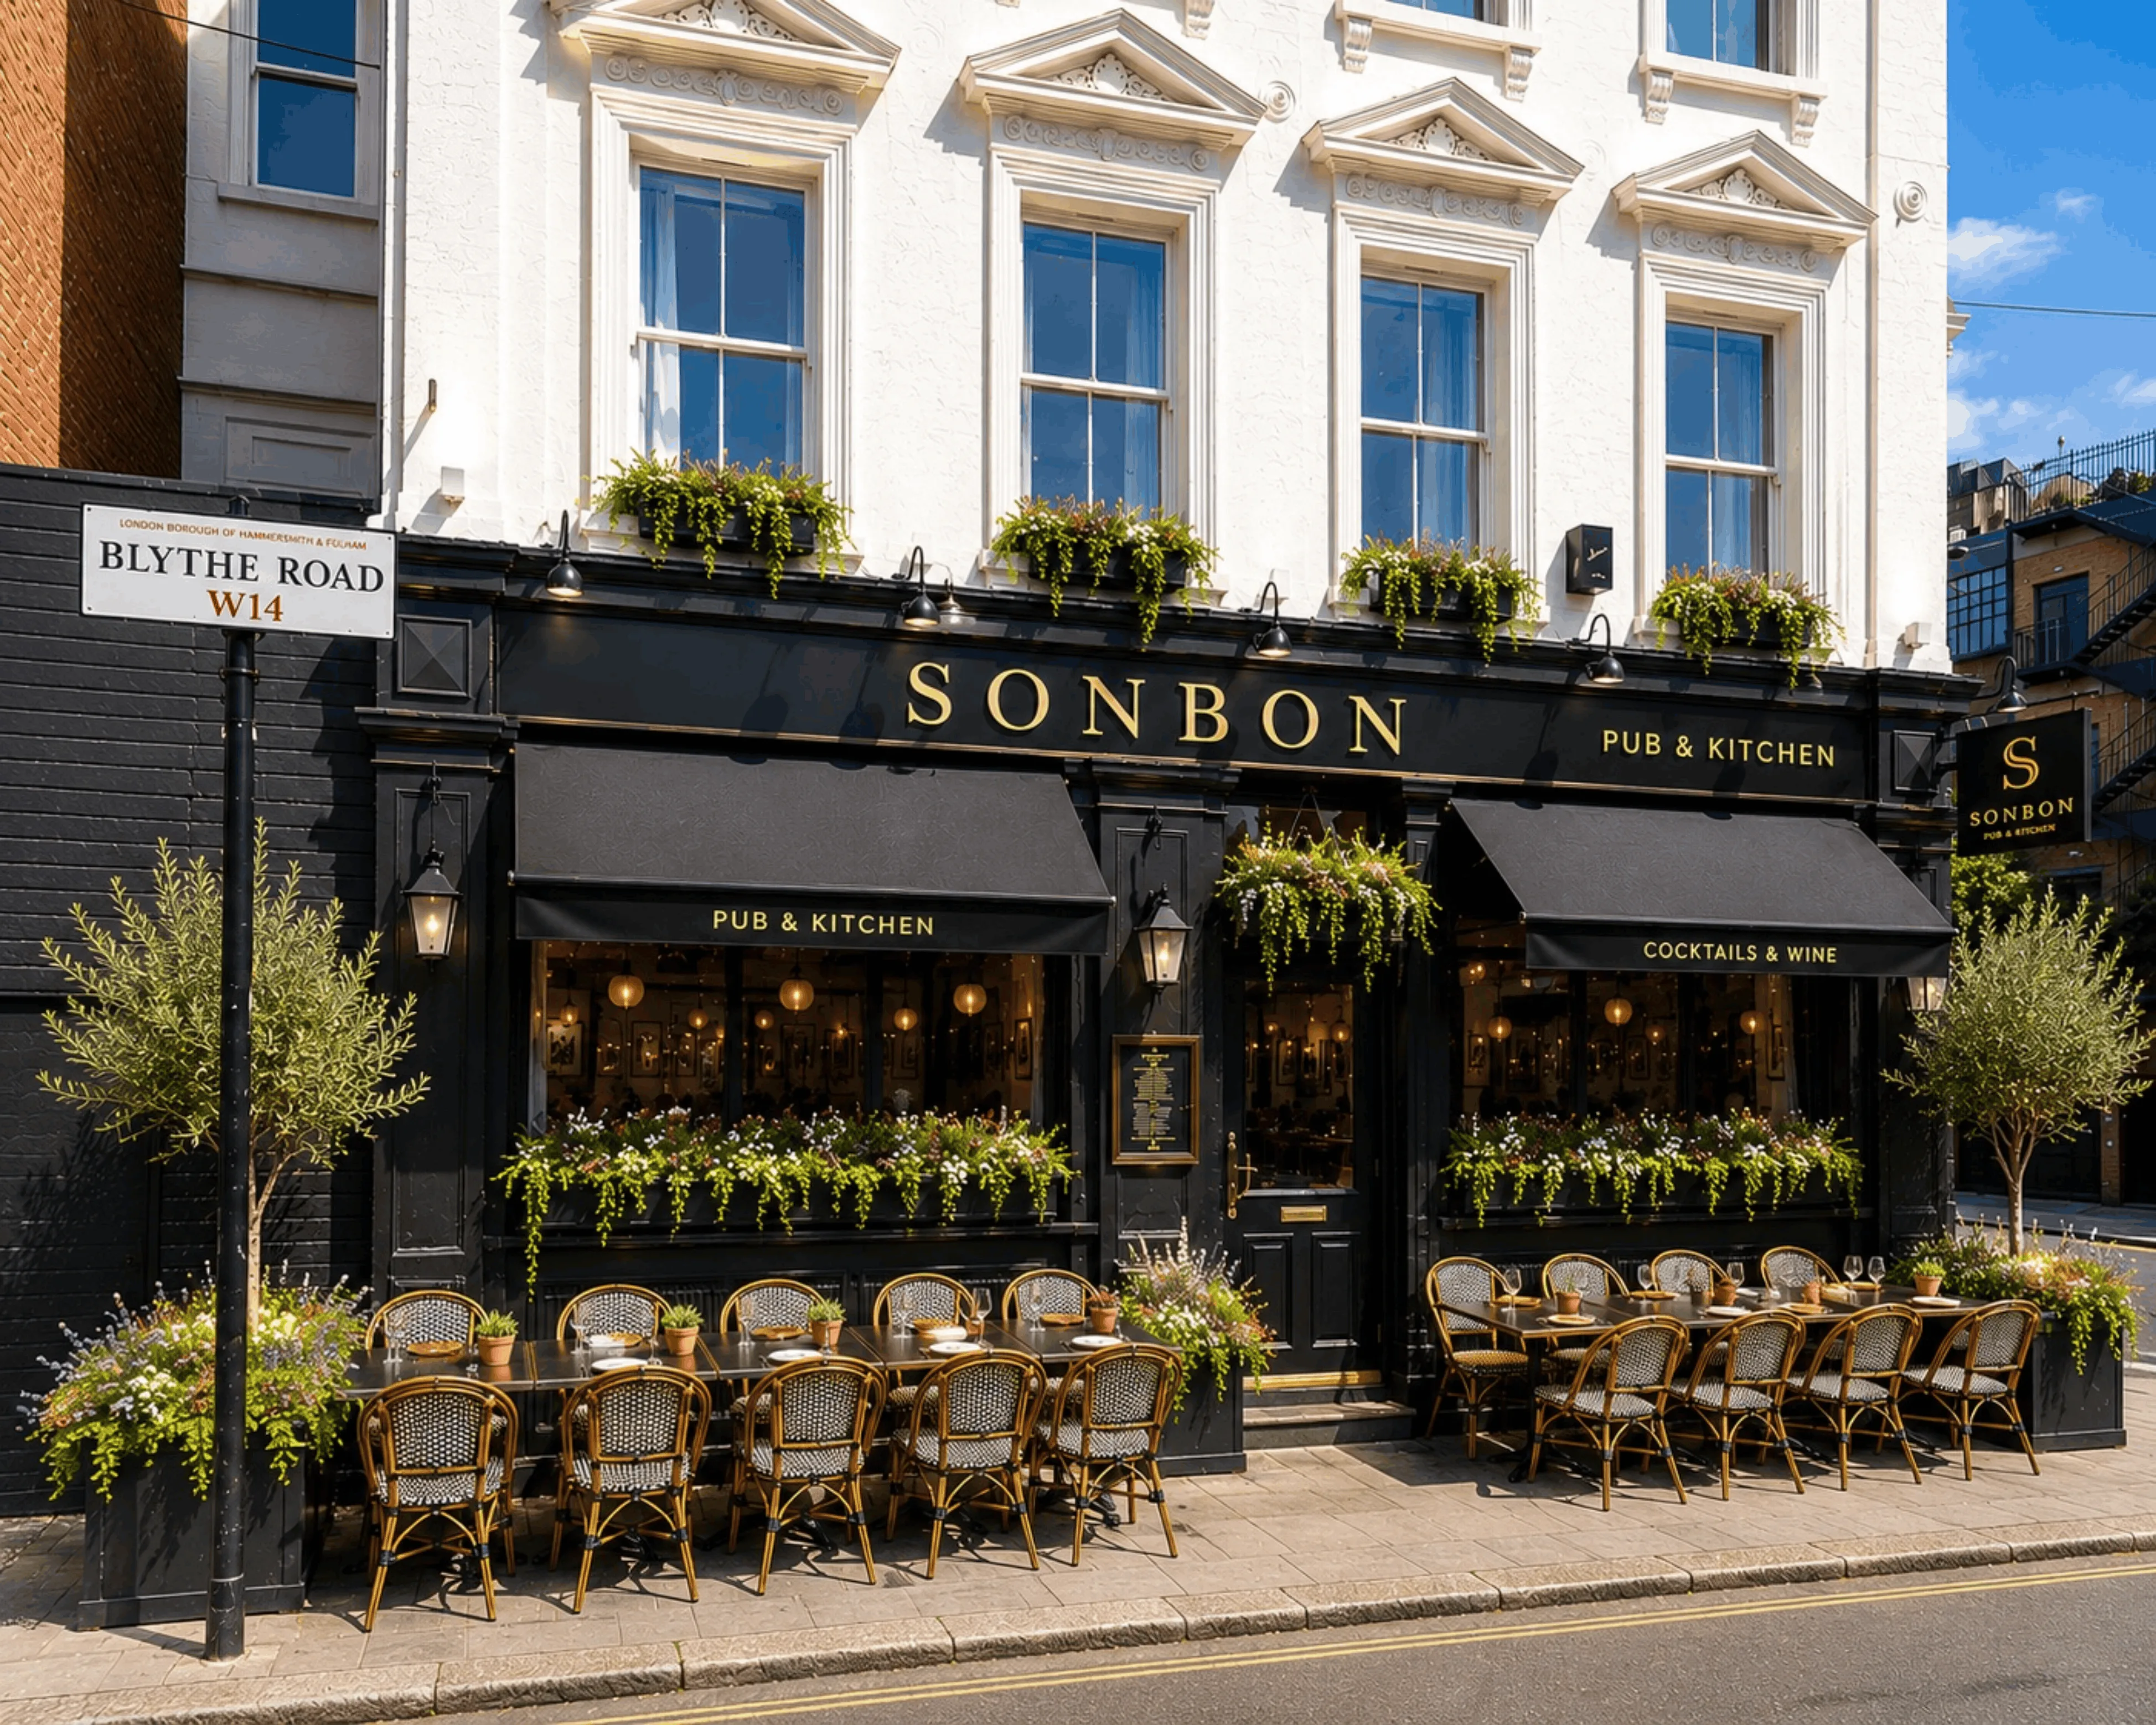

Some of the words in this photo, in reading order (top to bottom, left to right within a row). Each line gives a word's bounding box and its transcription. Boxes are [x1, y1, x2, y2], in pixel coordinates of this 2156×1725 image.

[120, 519, 164, 531] LONDON
[167, 523, 219, 536] BOROUGH
[223, 528, 236, 537] OF
[99, 541, 259, 582] BLYTHE
[278, 557, 384, 592] ROAD
[207, 589, 283, 622] W14
[907, 662, 1407, 756] SONBON
[1603, 729, 1661, 755] PUB
[1676, 735, 1694, 758] &
[1709, 737, 1834, 767] KITCHEN
[2003, 735, 2040, 790] S
[1969, 797, 2074, 827] SONBON
[713, 910, 768, 930] PUB
[781, 911, 799, 932] &
[812, 913, 933, 935] KITCHEN
[1643, 941, 1758, 962] COCKTAILS
[1765, 945, 1779, 962] &
[1787, 946, 1837, 963] WINE
